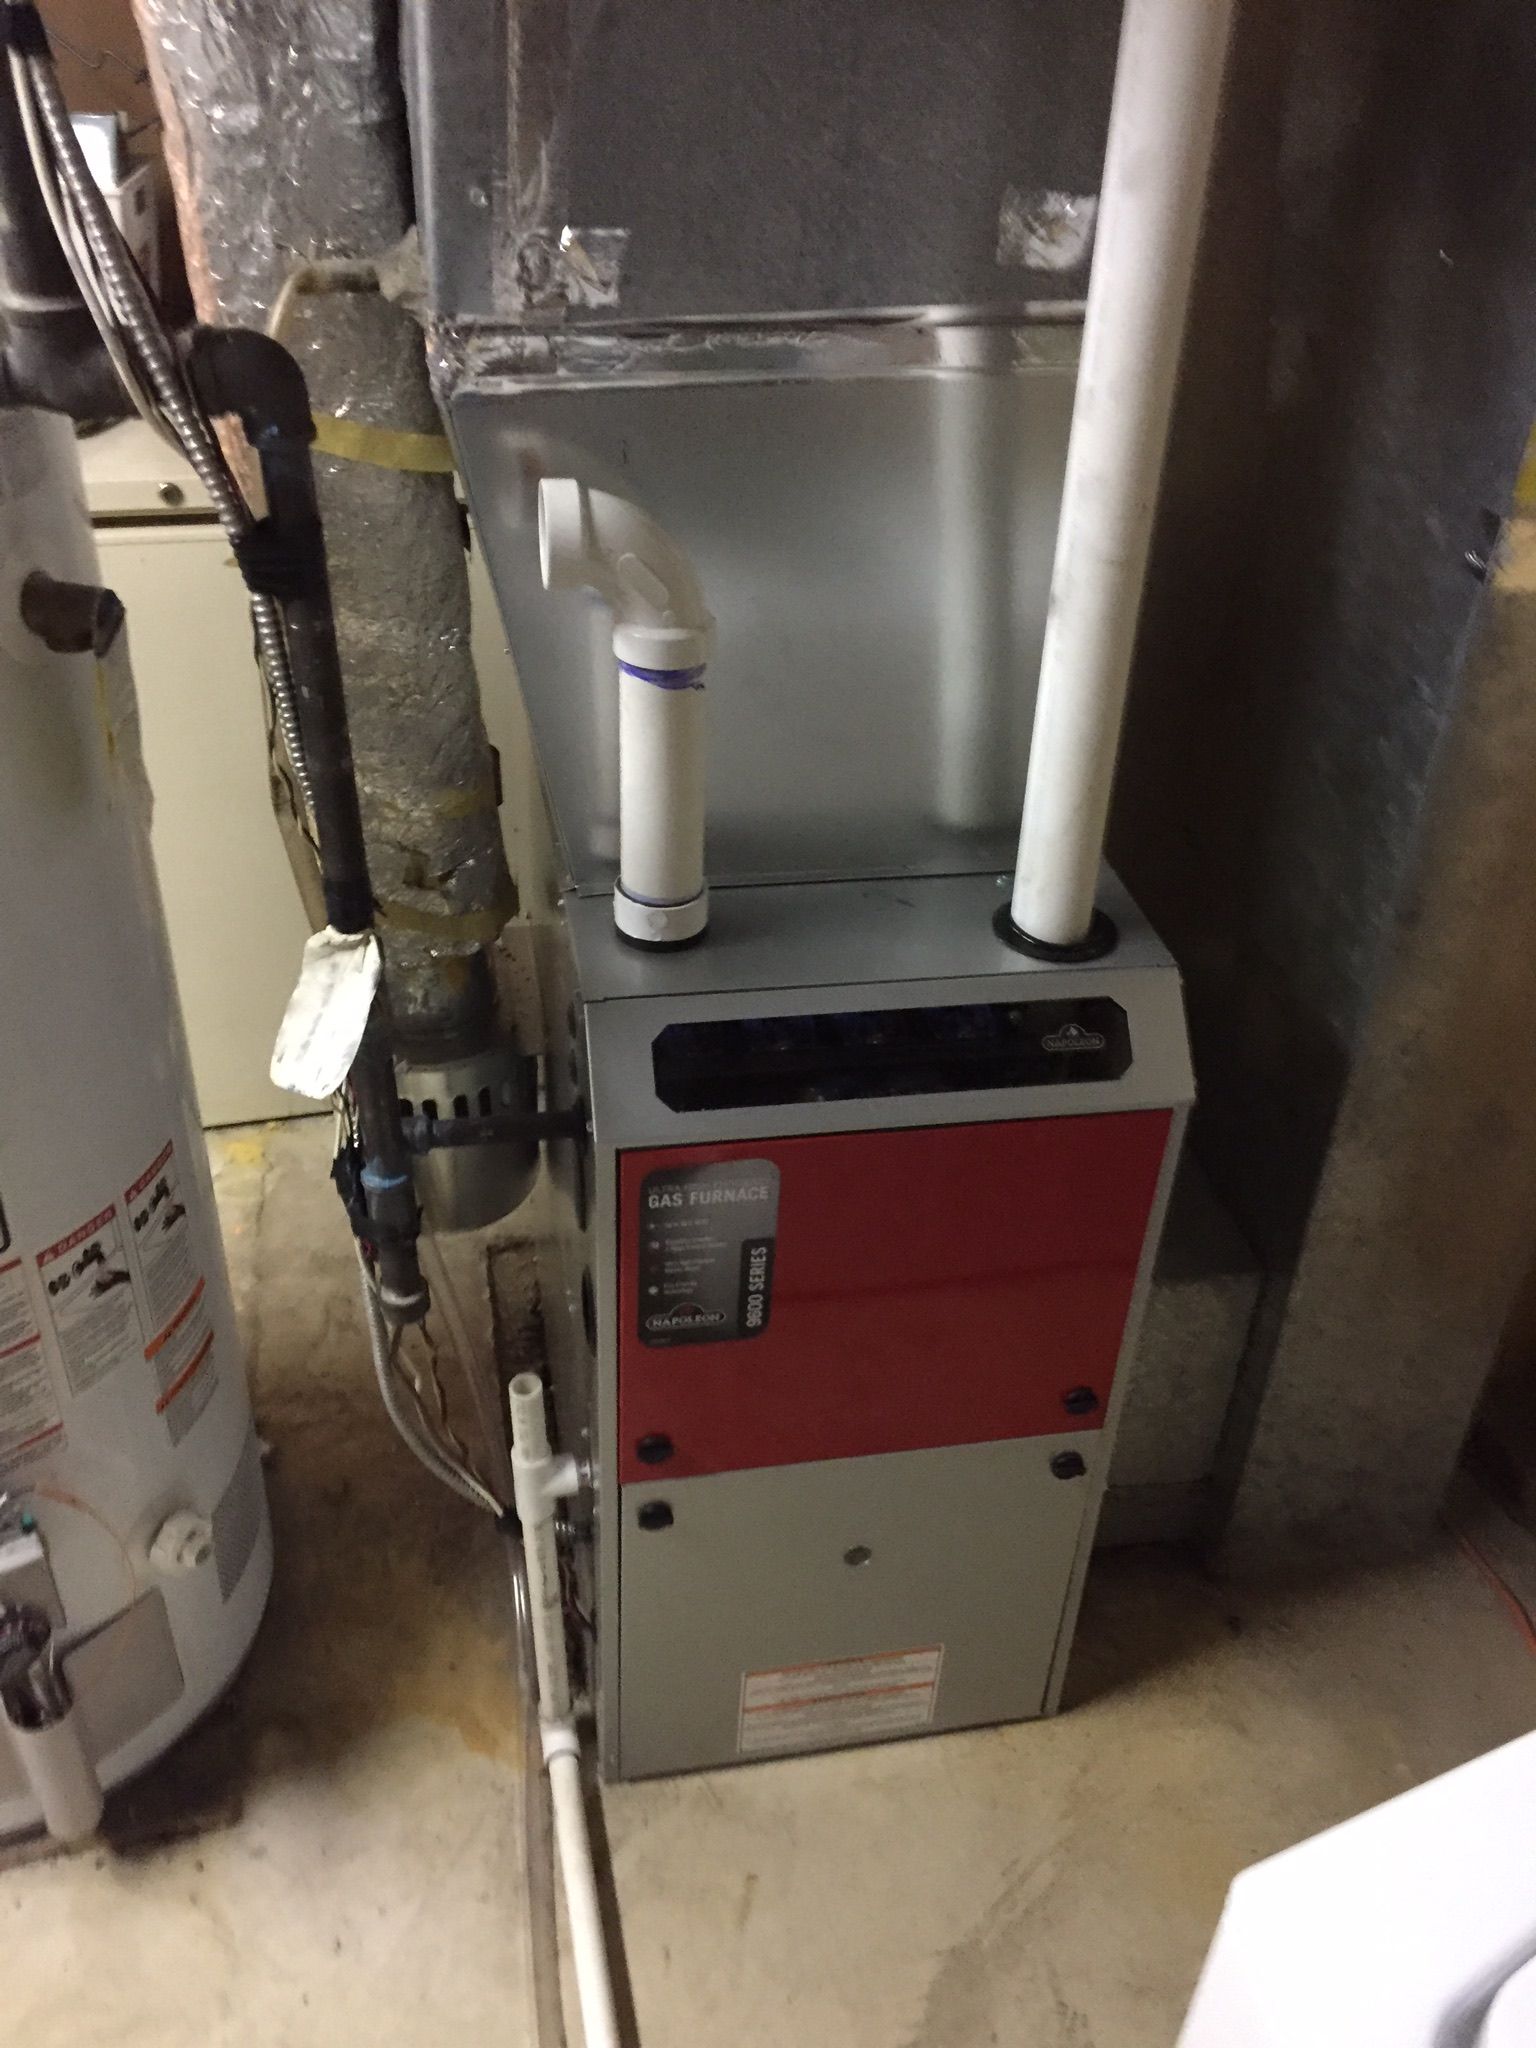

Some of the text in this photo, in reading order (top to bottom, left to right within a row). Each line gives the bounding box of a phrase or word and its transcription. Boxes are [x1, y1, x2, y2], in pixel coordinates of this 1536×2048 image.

[648, 1186, 769, 1209] GAS FURNACE
[749, 1246, 767, 1291] SERIES
[652, 1313, 720, 1327] NAPOLEON
